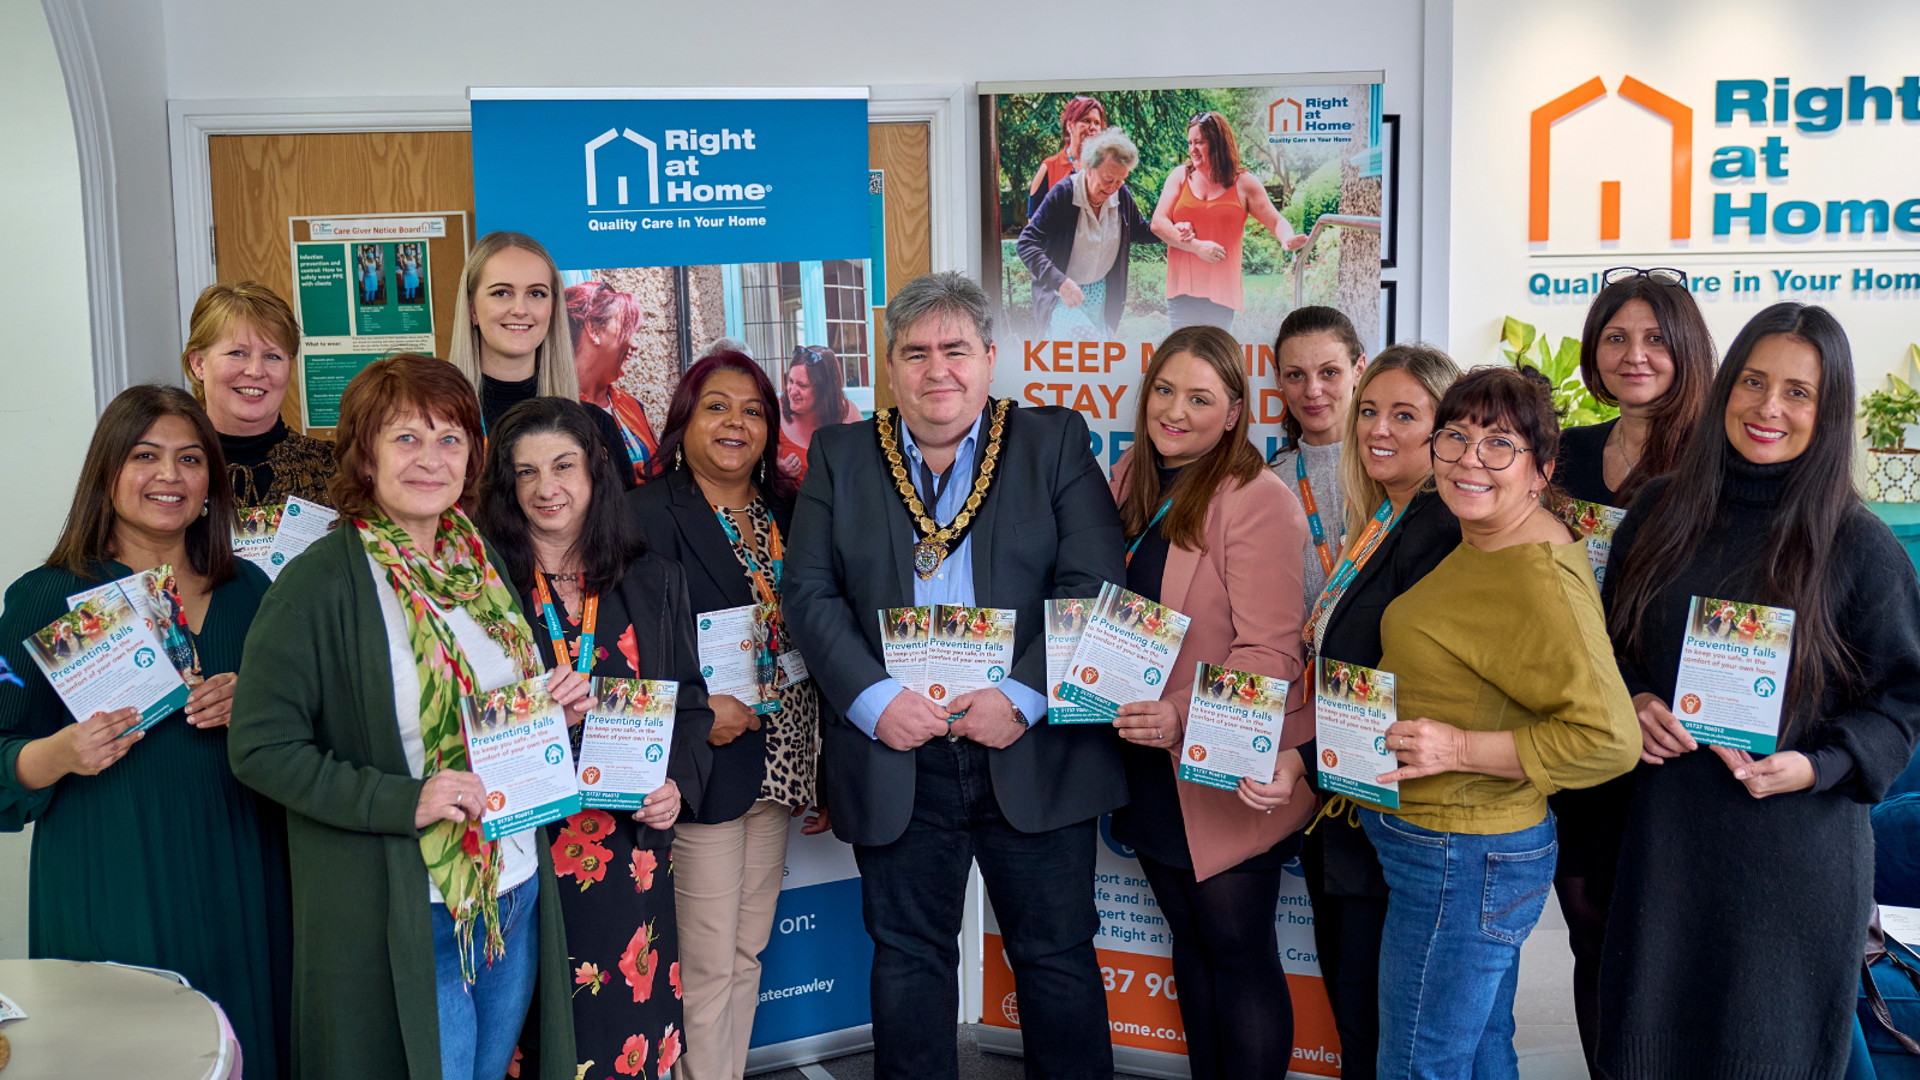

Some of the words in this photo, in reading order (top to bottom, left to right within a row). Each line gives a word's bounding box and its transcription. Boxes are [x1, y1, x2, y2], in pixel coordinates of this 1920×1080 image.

[1306, 97, 1348, 109] Right
[1716, 76, 1920, 132] Right
[1305, 110, 1321, 119] at
[665, 128, 756, 156] Right
[665, 156, 699, 176] at
[1710, 137, 1789, 178] at
[588, 219, 637, 232] Quality
[641, 218, 674, 229] Care
[678, 217, 690, 228] in
[695, 216, 724, 227] Your
[728, 215, 766, 226] Home
[1529, 272, 1603, 296] Qual
[1734, 271, 1760, 293] in
[1773, 270, 1842, 292] Your
[1854, 268, 1920, 290] Hom
[1024, 340, 1126, 374] KEEP
[1024, 382, 1128, 420] STAY
[233, 536, 275, 546] Preventi
[885, 642, 928, 651] Preventi
[1048, 634, 1082, 643] Preven
[1686, 636, 1749, 656] Preventing
[1753, 645, 1776, 658] falls
[49, 640, 111, 682] Preventing
[109, 624, 134, 642] falls
[588, 714, 641, 727] Preventing
[644, 717, 663, 726] falls
[470, 724, 530, 748] Preventing
[532, 715, 554, 729] falls
[1124, 877, 1149, 888] and
[1115, 893, 1139, 905] and
[780, 913, 816, 934] on:
[1130, 911, 1164, 925] team
[1112, 925, 1146, 942] Right
[1150, 932, 1164, 943] at
